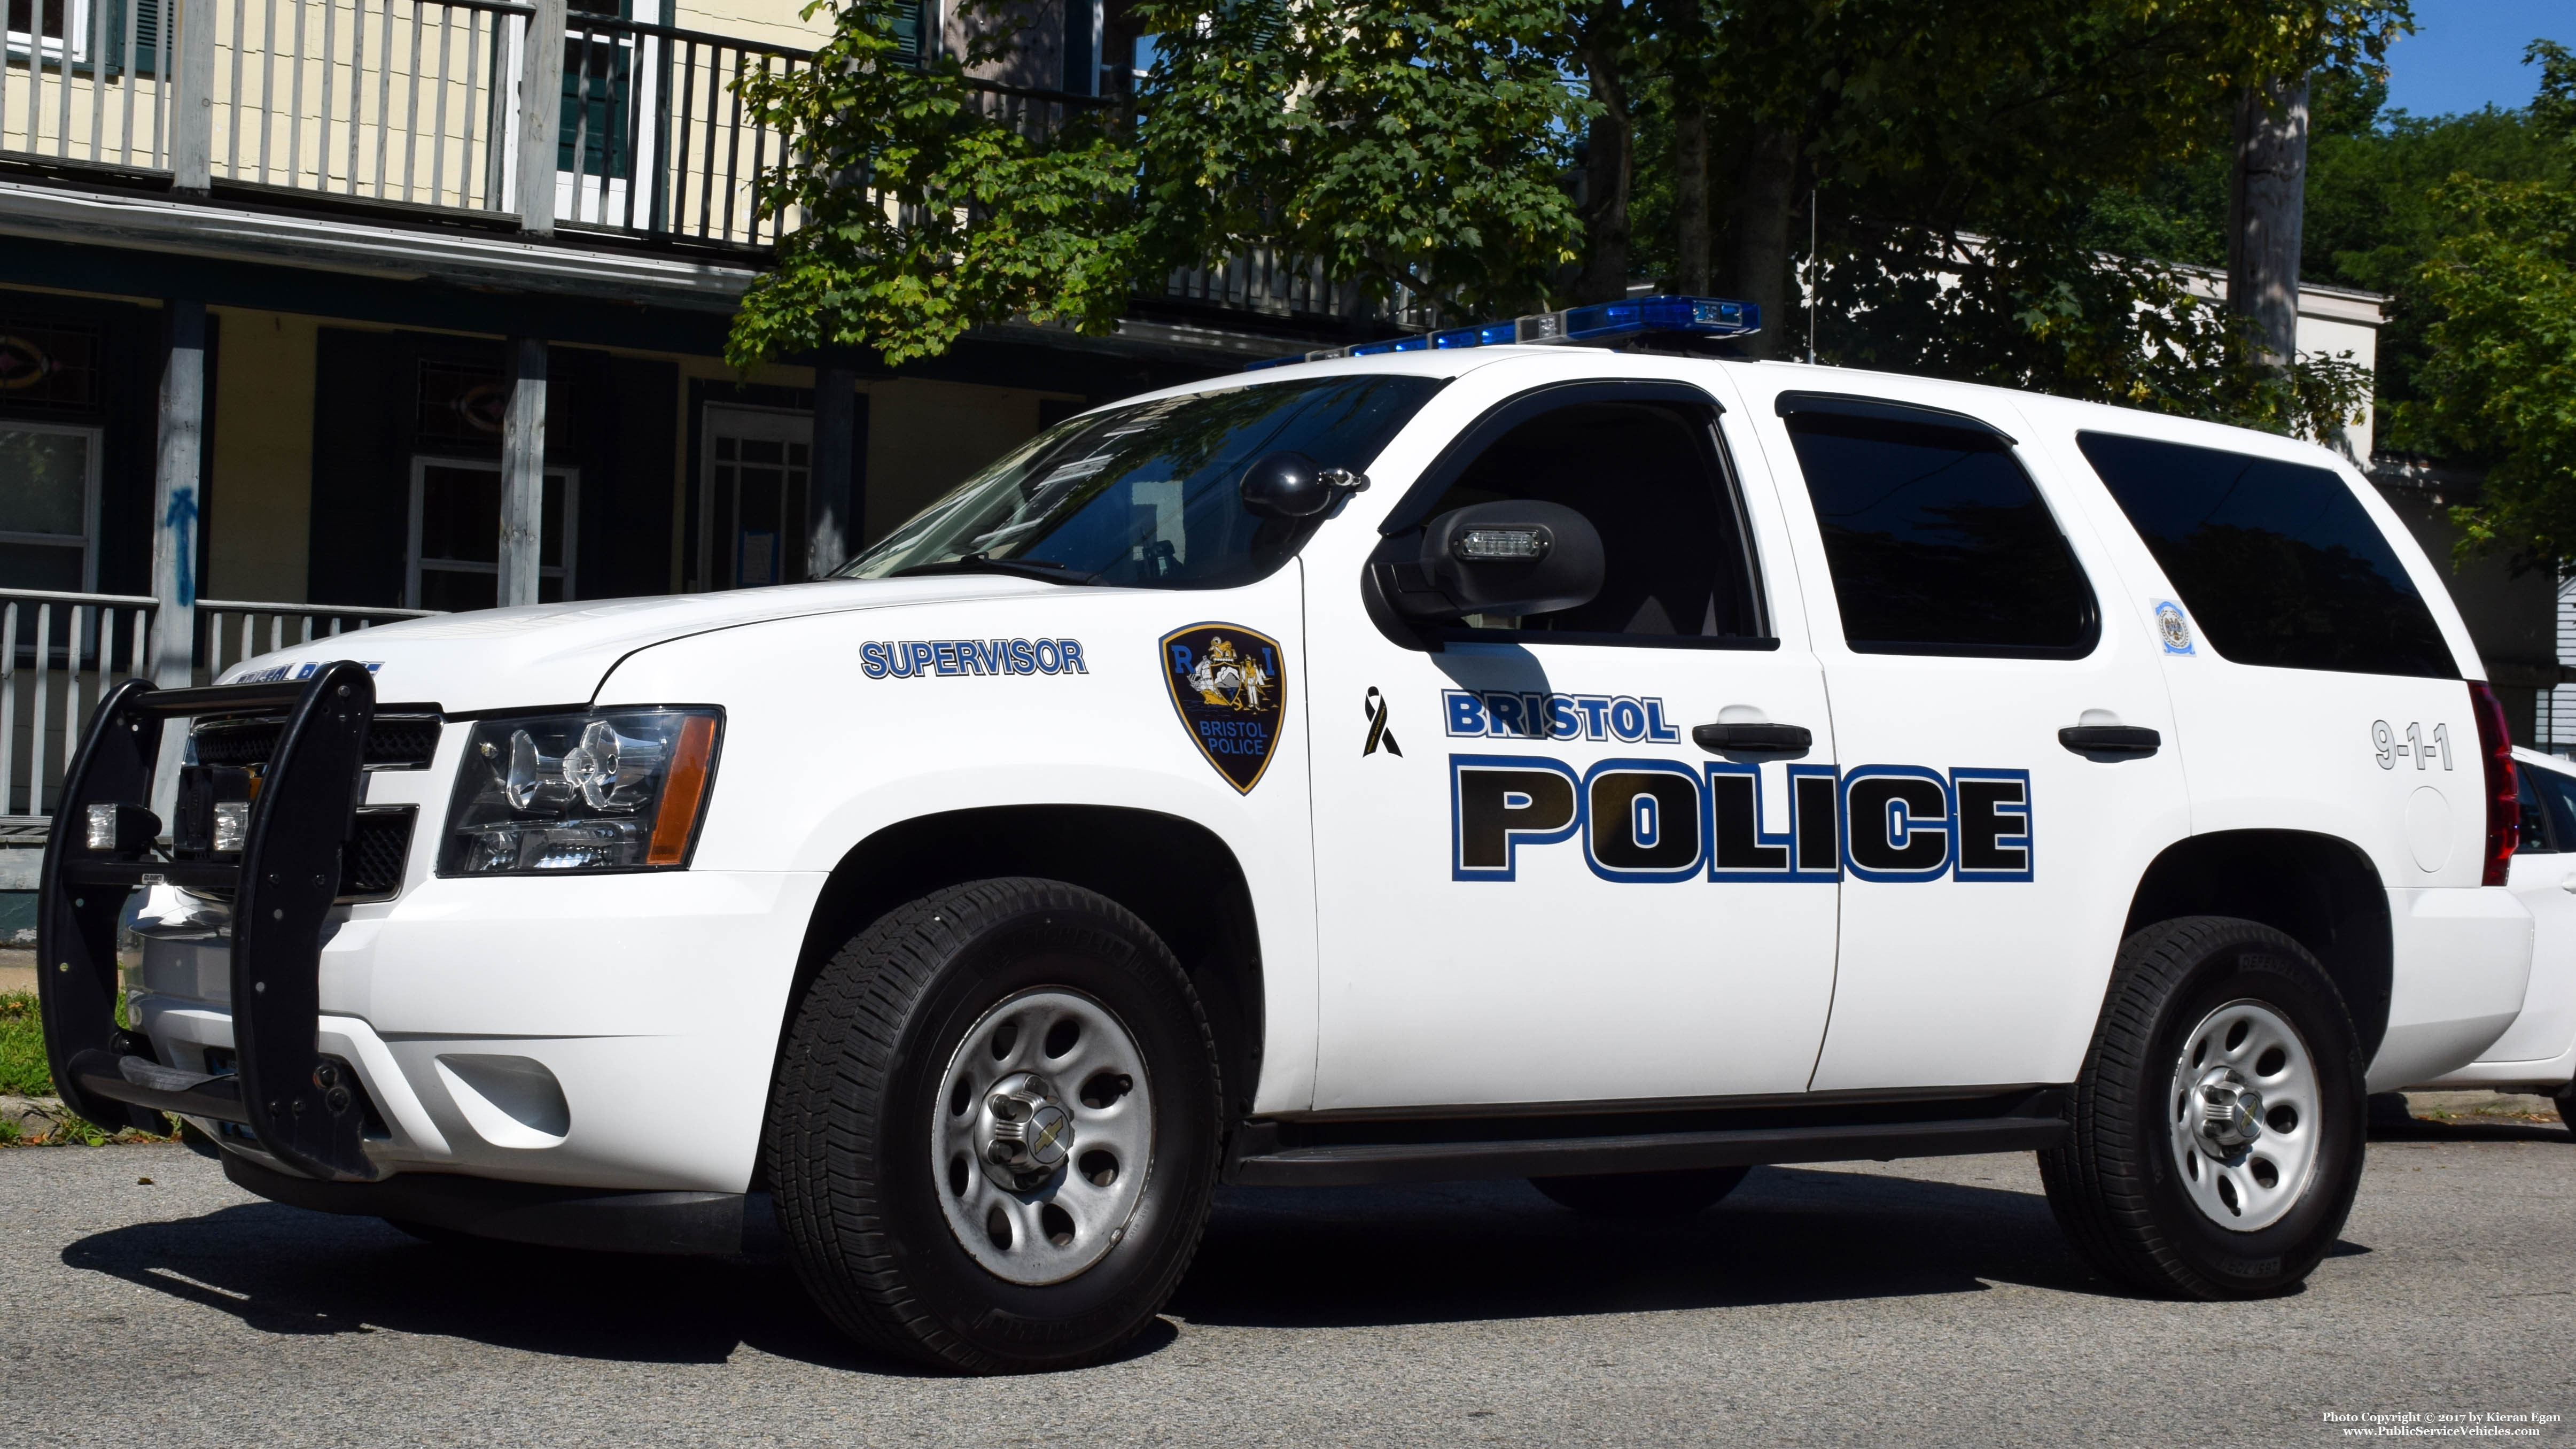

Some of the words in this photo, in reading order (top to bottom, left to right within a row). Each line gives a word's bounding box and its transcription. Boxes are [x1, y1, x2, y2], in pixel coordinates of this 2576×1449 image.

[859, 638, 1090, 679] SUPERVISOR
[1171, 645, 1195, 673] R
[1262, 648, 1275, 676] I
[1200, 721, 1268, 738] BRISTOL
[1441, 688, 1681, 744] BRISTOL
[1208, 738, 1265, 755] POLICE
[2371, 719, 2453, 771] 9-1-1
[1449, 754, 2034, 882] POLICE
